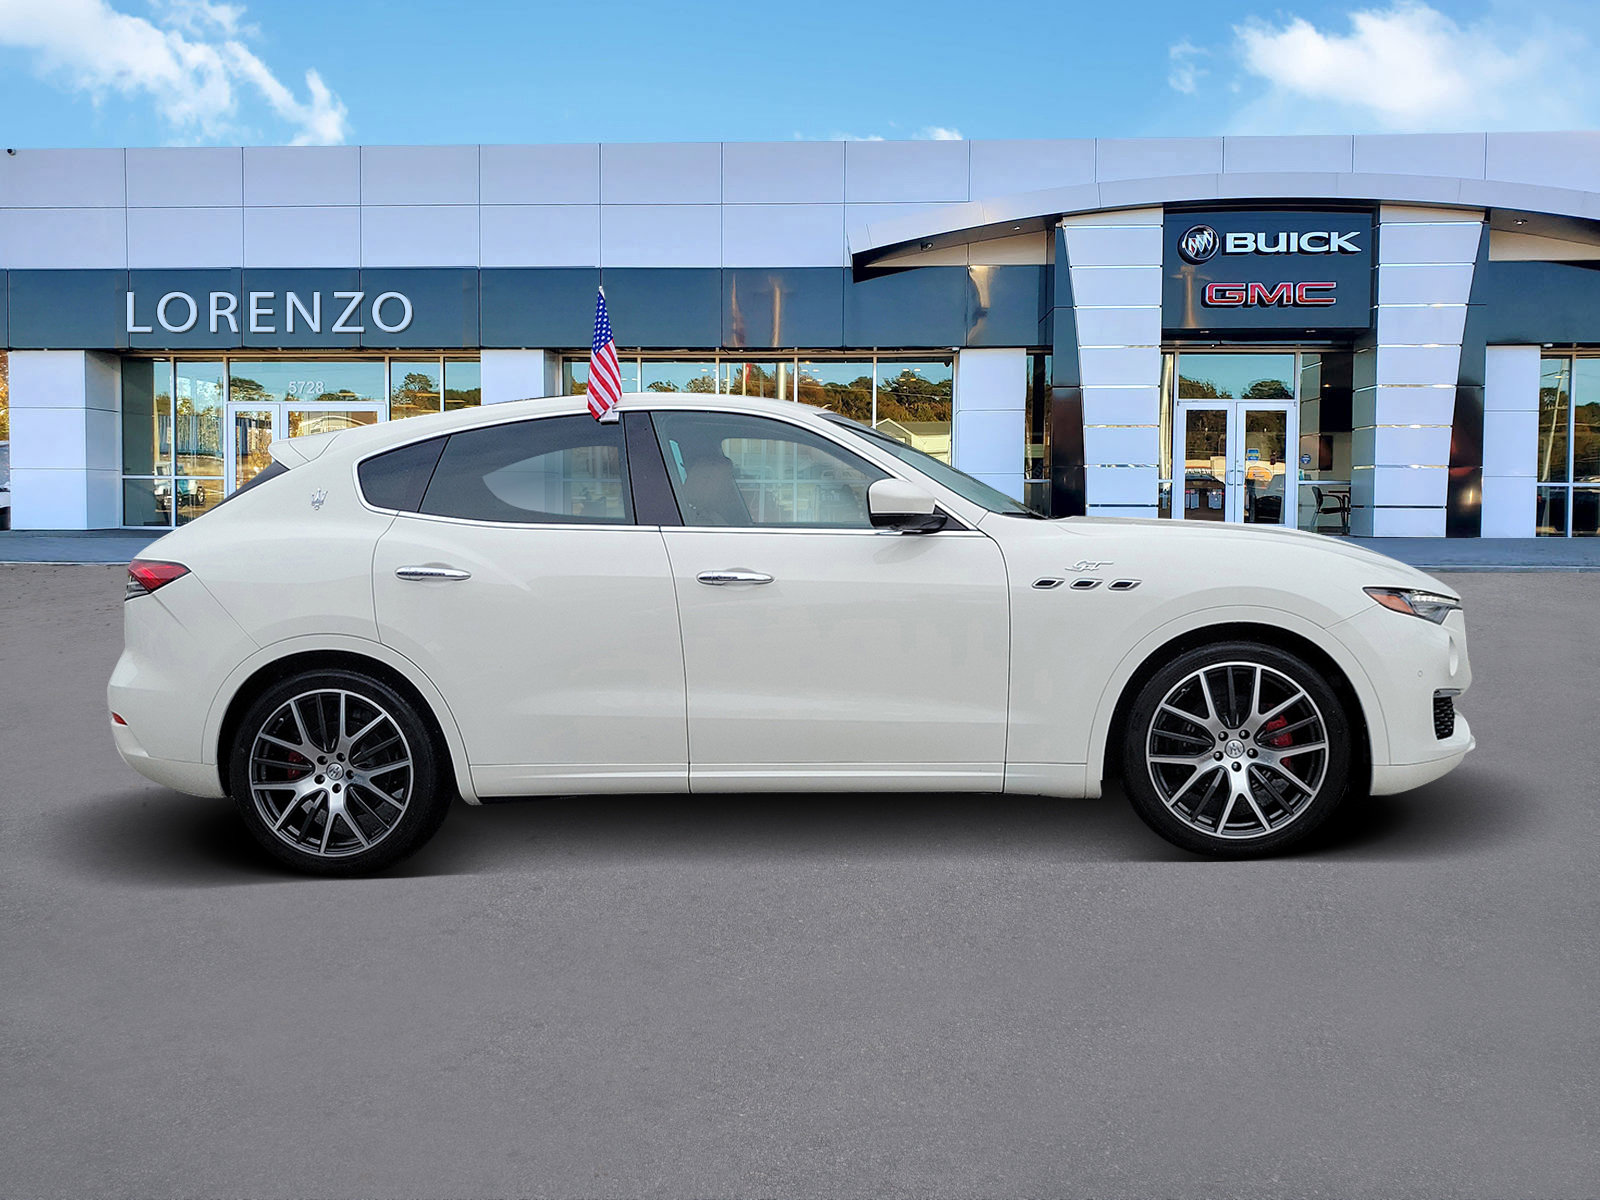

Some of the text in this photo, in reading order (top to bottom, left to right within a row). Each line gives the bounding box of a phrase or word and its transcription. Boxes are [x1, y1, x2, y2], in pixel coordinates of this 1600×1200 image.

[1225, 231, 1362, 253] BUICK
[1204, 281, 1337, 305] GMC
[126, 291, 413, 333] LORENZO
[288, 380, 326, 395] 5728
